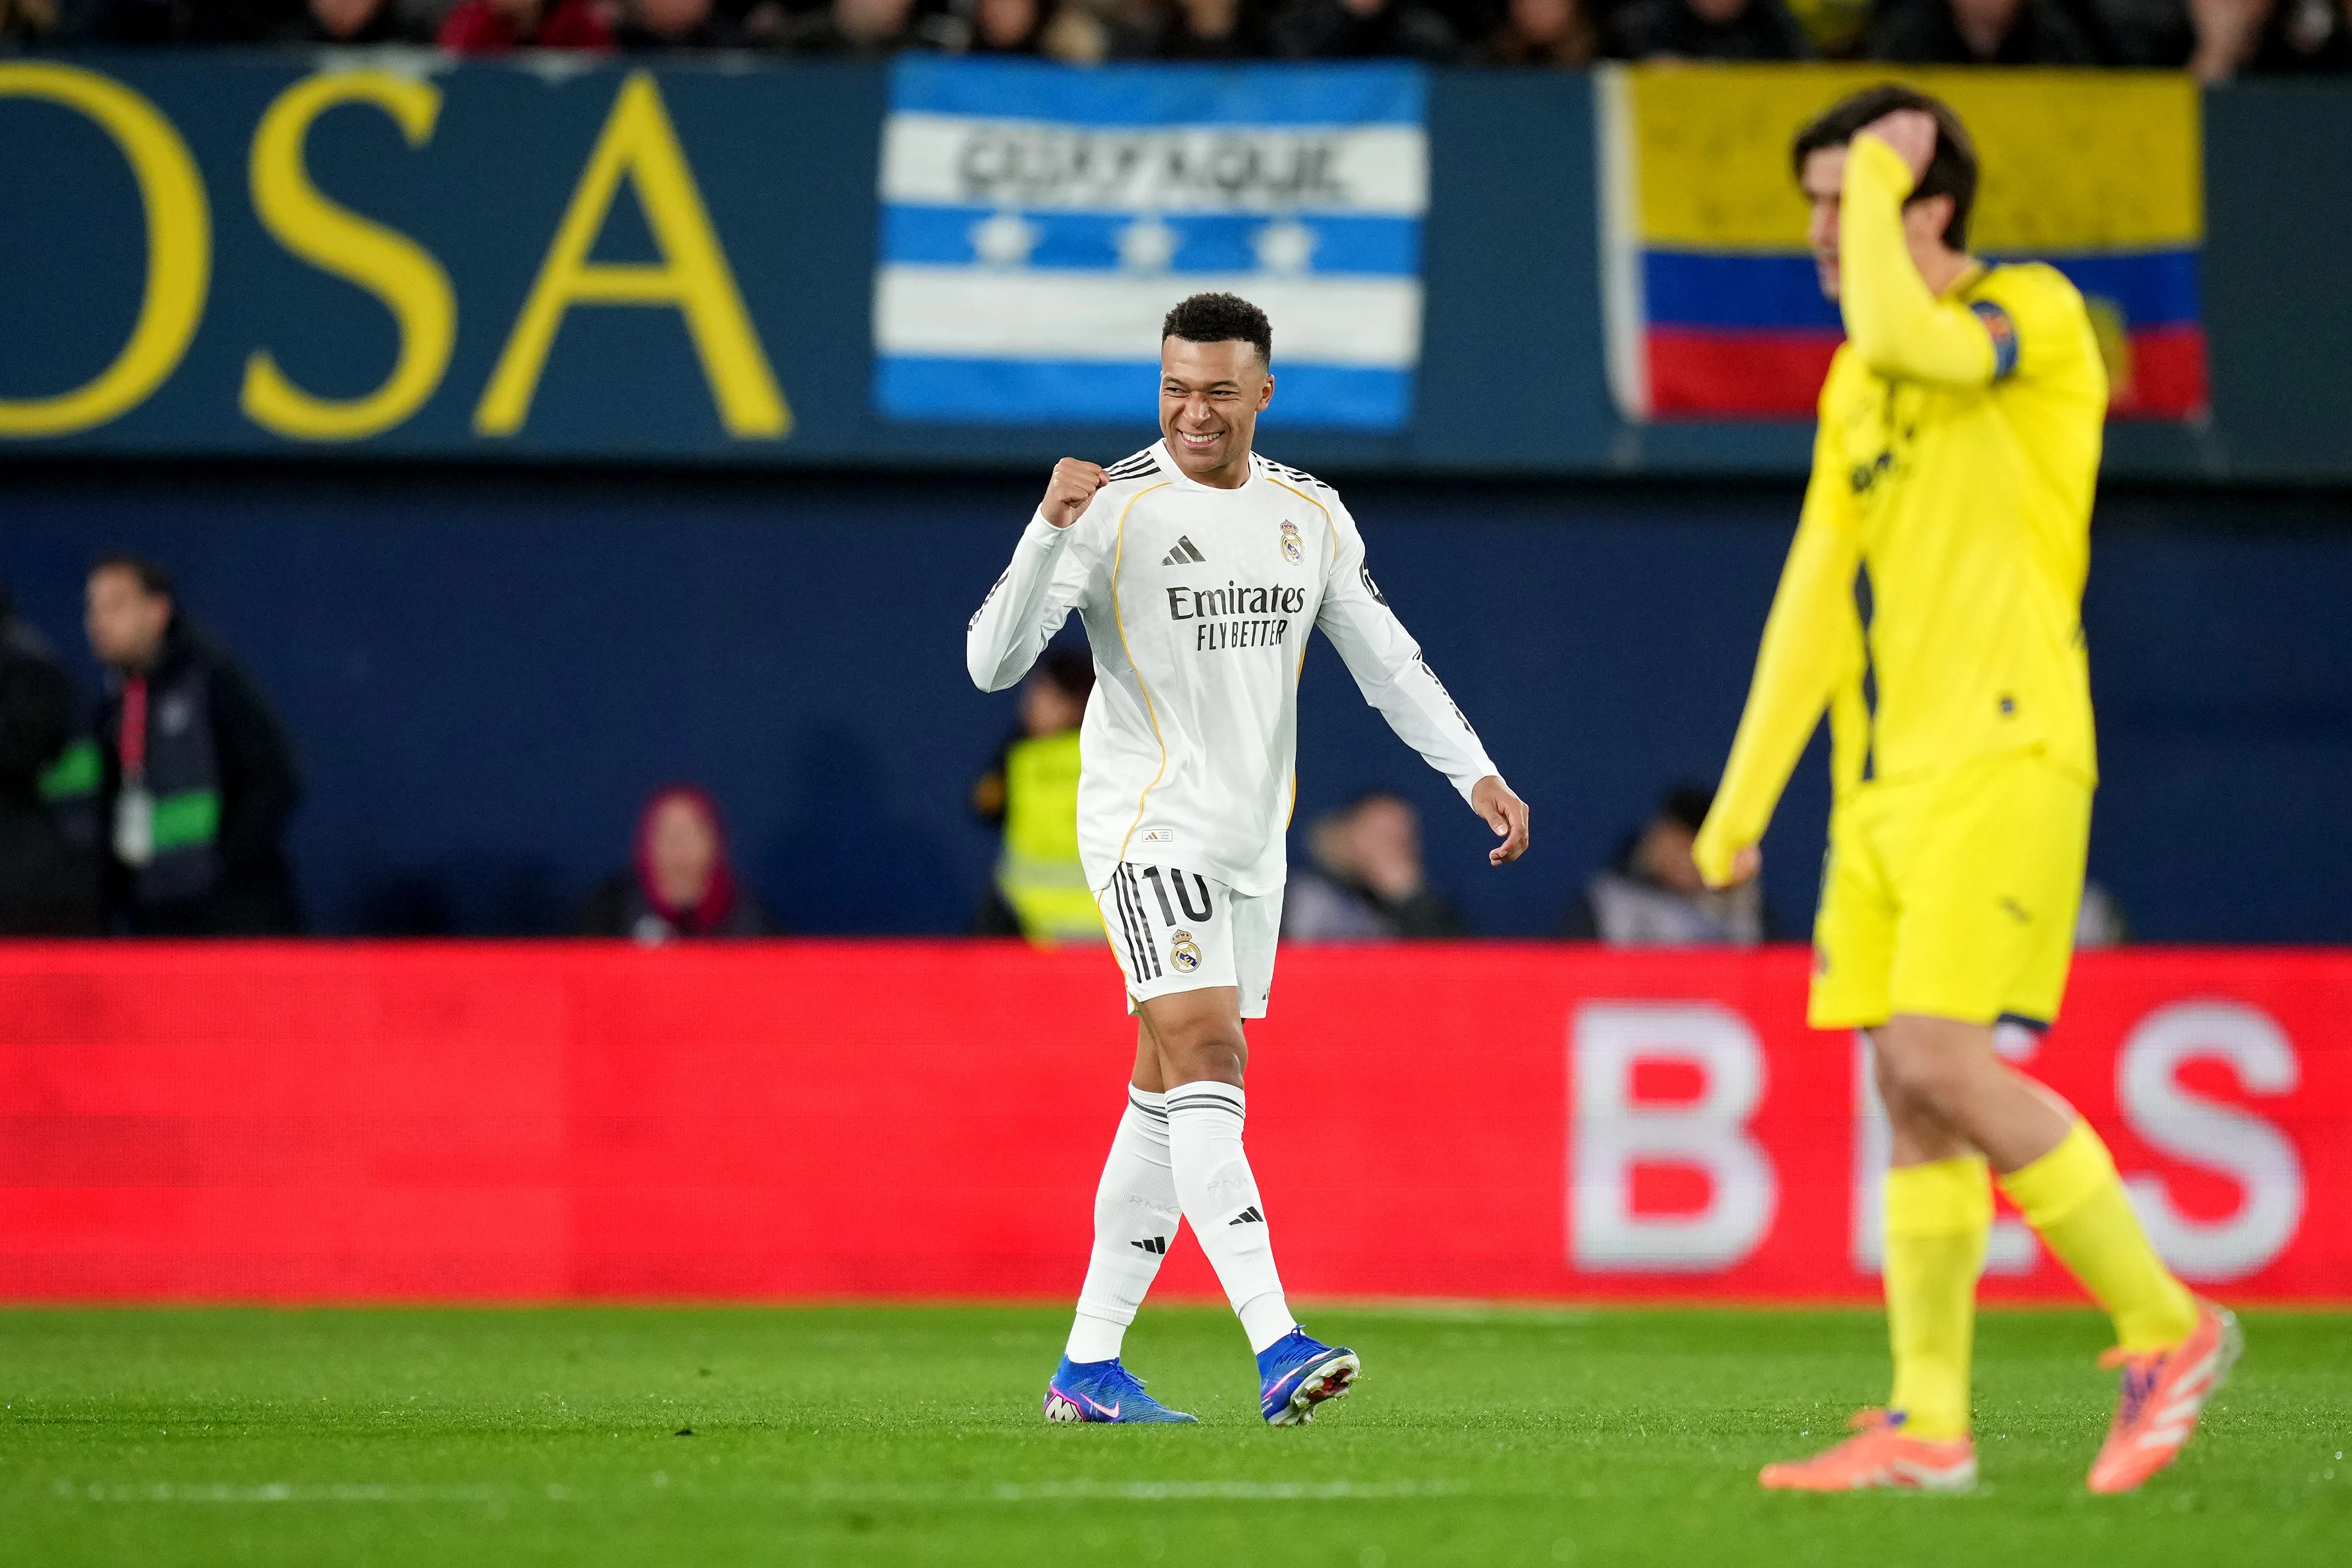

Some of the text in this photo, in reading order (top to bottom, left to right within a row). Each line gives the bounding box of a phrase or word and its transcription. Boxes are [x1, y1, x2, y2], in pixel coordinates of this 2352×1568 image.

[0, 60, 795, 441] OSA
[1165, 580, 1305, 620] Emirates
[1142, 865, 1212, 927] 10
